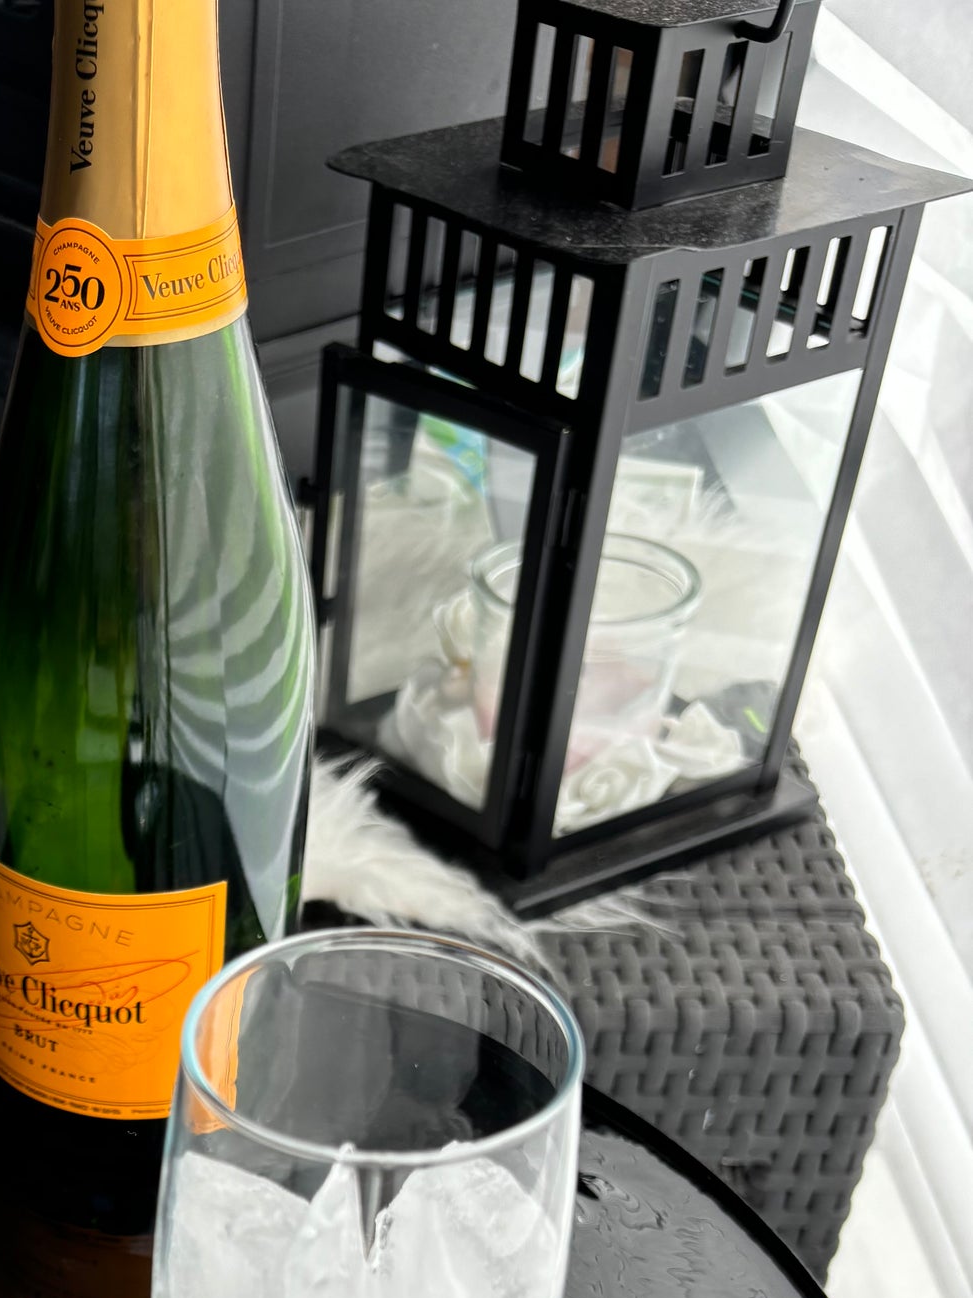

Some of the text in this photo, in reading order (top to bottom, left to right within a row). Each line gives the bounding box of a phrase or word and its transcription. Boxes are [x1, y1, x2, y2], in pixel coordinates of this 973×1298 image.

[70, 89, 96, 174] Veuve
[53, 242, 100, 264] CHAMPAGNE
[44, 263, 105, 310] 250
[139, 272, 205, 300] Veuve
[45, 306, 97, 335] VEUVE CLICQUOT
[60, 299, 81, 312] ANS
[22, 975, 147, 1028] Clicquot
[14, 1022, 58, 1053] BRUT
